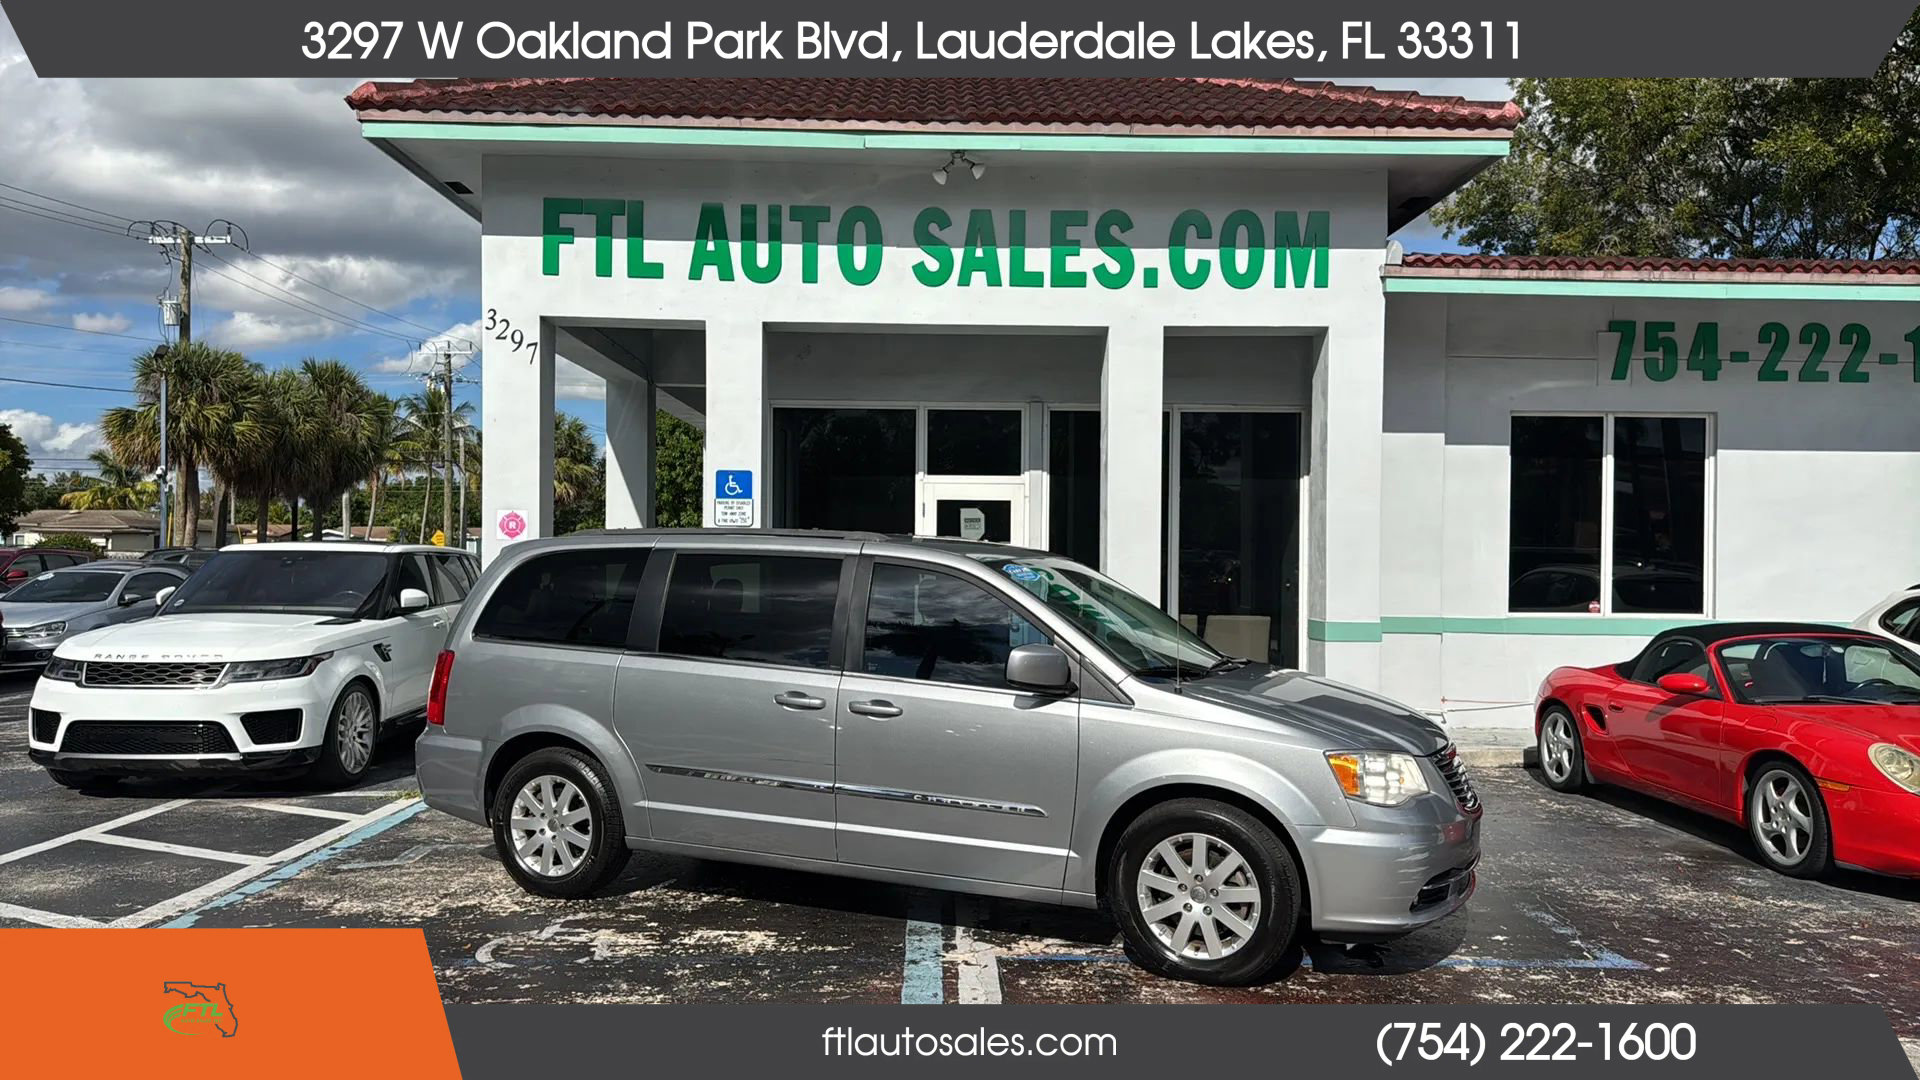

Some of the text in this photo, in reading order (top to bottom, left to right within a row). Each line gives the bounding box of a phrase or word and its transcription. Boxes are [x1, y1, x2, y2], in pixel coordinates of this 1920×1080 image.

[540, 198, 1332, 292] FTL AUTO SALES.COM
[485, 308, 538, 365] 3297
[508, 520, 517, 529] R
